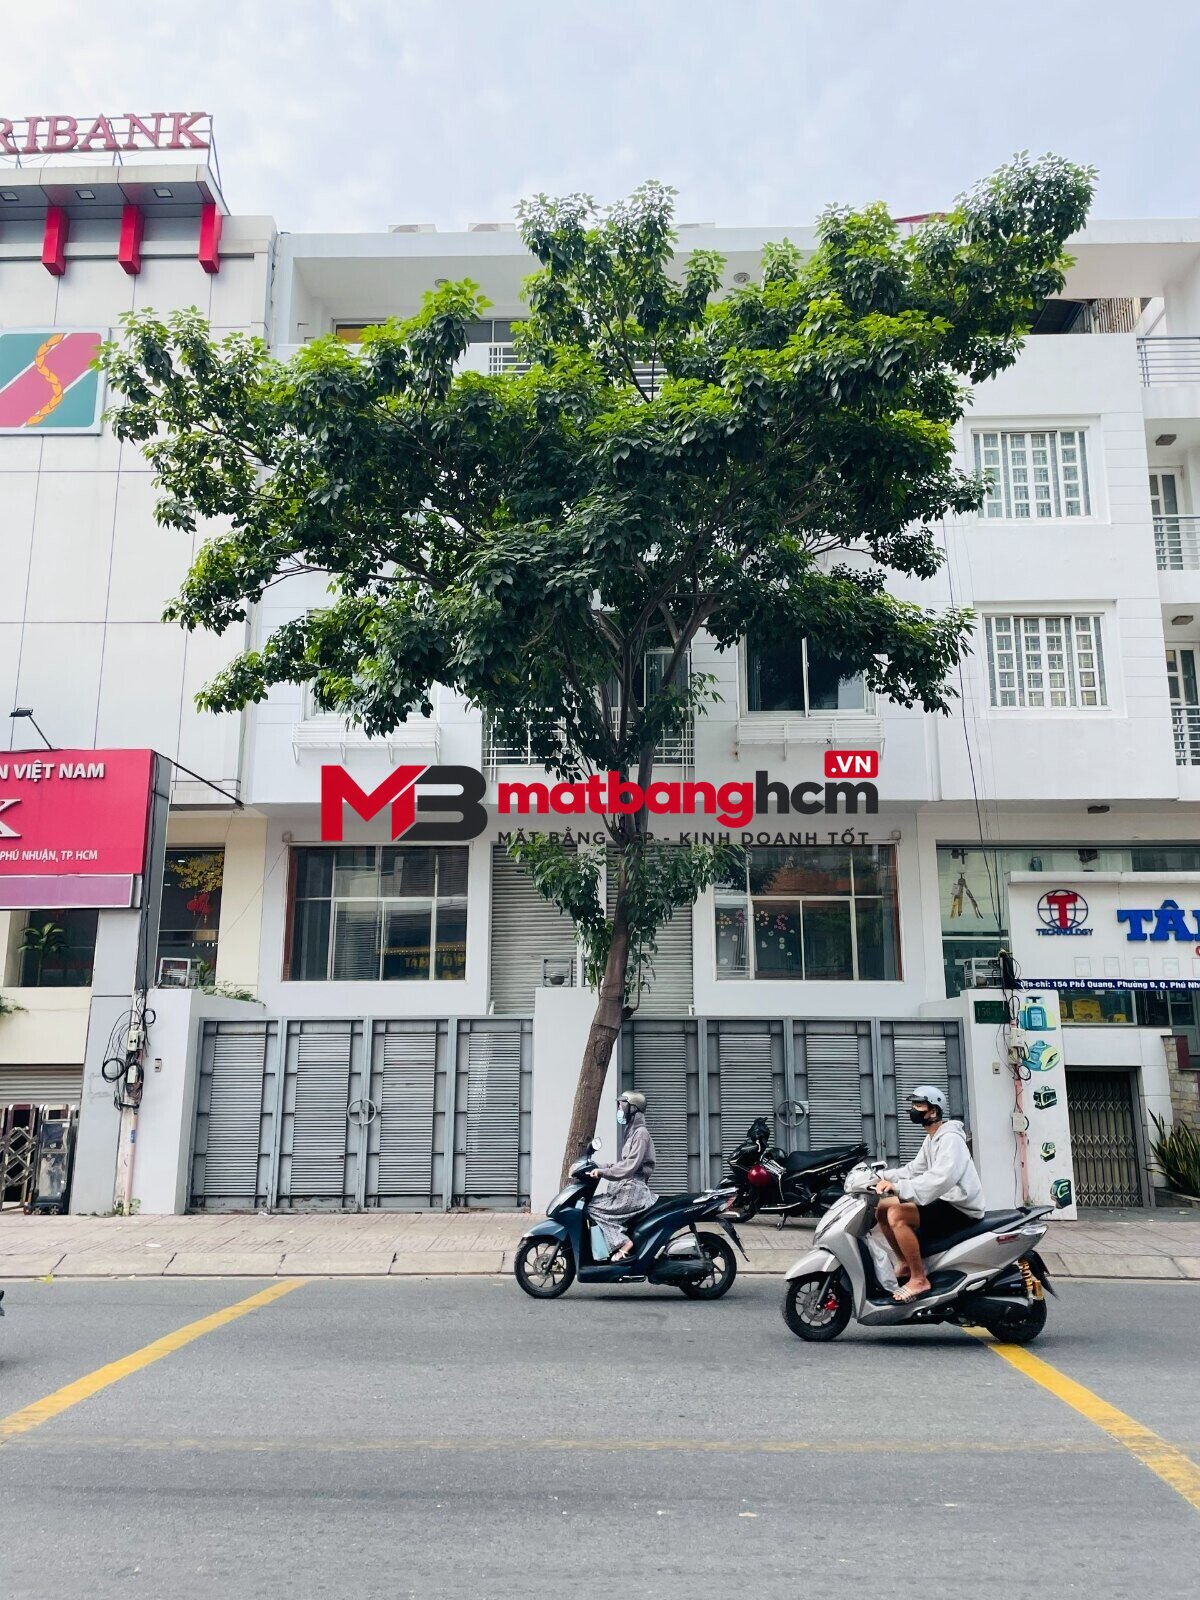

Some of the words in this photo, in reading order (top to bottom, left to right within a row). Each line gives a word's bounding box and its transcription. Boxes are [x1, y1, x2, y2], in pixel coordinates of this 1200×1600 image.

[13, 759, 55, 782] VIỆT
[59, 762, 105, 779] NAM
[0, 848, 19, 861] PHÚ
[22, 848, 59, 863] NHUẬN,
[61, 850, 74, 861] TP.
[75, 849, 98, 860] HCM
[1046, 893, 1078, 929] T
[1116, 900, 1200, 941] TÂ
[1035, 928, 1094, 936] TECHNOLOGY
[1117, 980, 1148, 990] Phường
[1170, 981, 1187, 989] Phú
